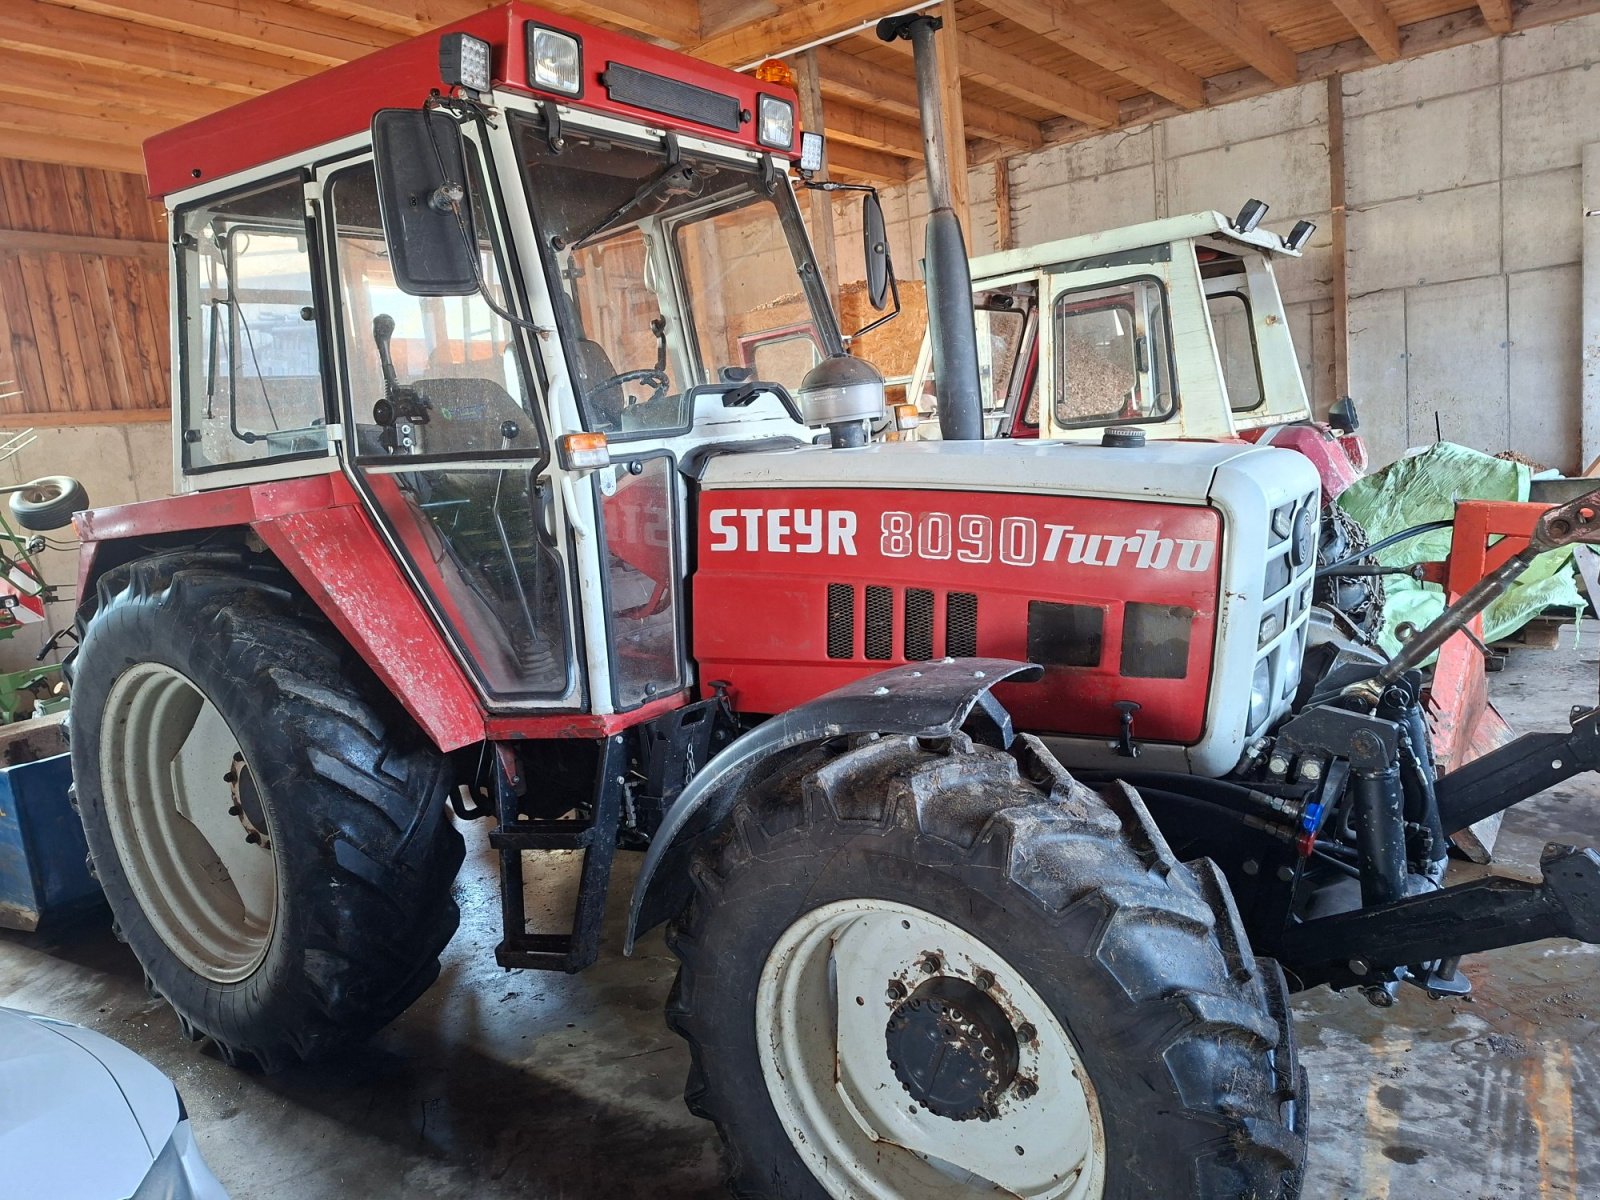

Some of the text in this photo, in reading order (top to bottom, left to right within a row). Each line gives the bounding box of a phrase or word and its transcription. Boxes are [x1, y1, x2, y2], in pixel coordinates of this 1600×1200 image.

[709, 508, 1215, 572] STEYR 8090 Turbo
